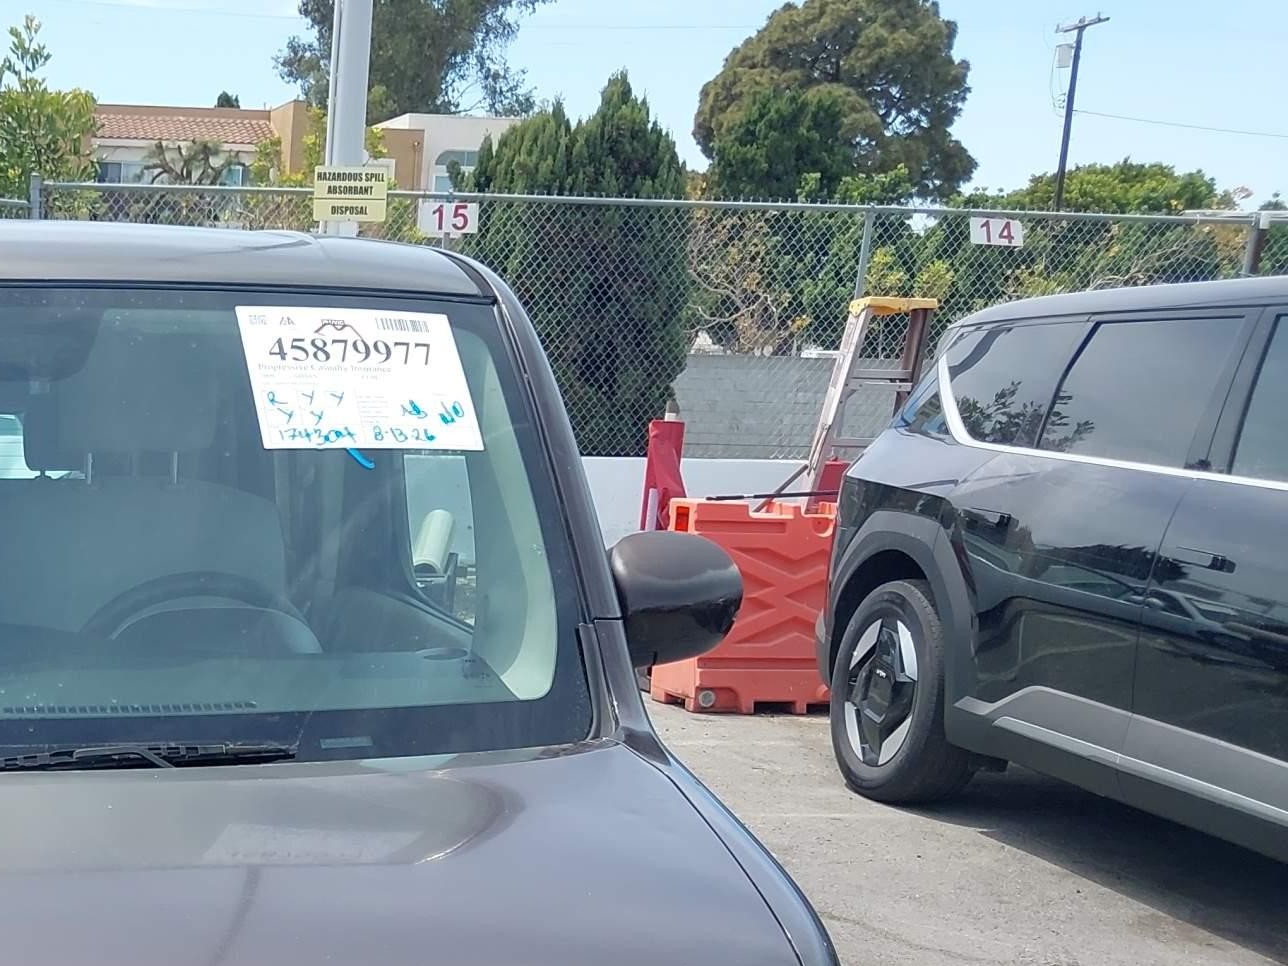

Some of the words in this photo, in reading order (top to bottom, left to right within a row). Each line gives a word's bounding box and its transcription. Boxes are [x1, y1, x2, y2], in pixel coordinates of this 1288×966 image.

[316, 171, 362, 182] HAZARDOUS
[364, 172, 385, 182] SPILL
[327, 185, 374, 195] ABSORBANT
[330, 205, 368, 216] DISPOSAL
[432, 204, 468, 231] 15
[980, 219, 1015, 244] 14
[269, 337, 431, 365] 45879977
